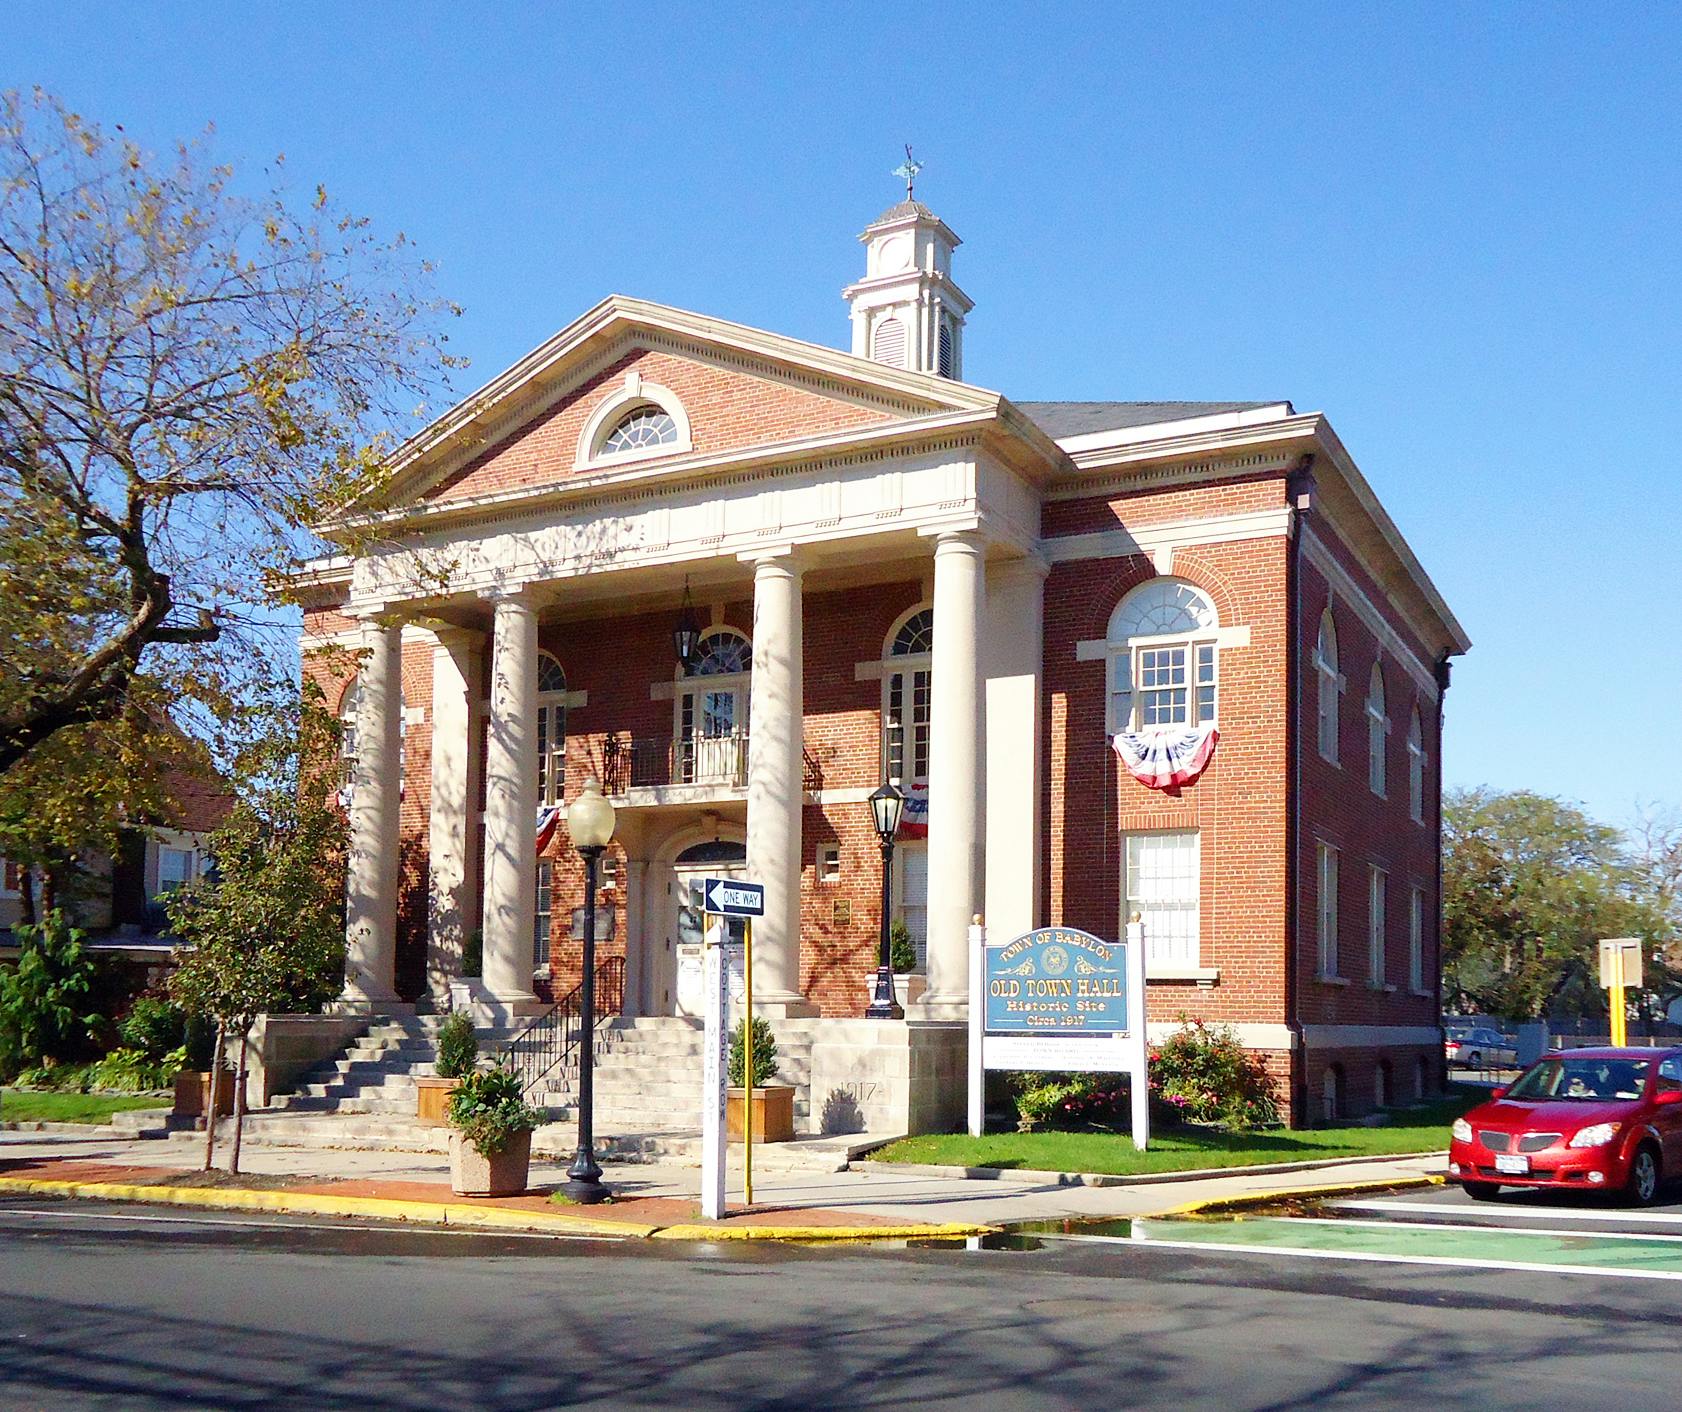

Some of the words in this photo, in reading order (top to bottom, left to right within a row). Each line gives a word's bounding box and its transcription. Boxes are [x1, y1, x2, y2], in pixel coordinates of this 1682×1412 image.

[723, 890, 740, 904] ONE
[742, 891, 759, 906] WAY
[999, 937, 1033, 962] TOWN
[1035, 932, 1052, 944] OF
[1055, 931, 1113, 961] BABYLON
[990, 979, 1020, 997] OLD
[1026, 979, 1072, 997] TOWN
[1077, 979, 1122, 998] HALL
[720, 957, 728, 1062] COTTAGE
[1006, 1000, 1069, 1012] Historic
[1076, 1001, 1106, 1012] Site
[1026, 1015, 1057, 1026] Circa
[1060, 1015, 1085, 1026] 1917
